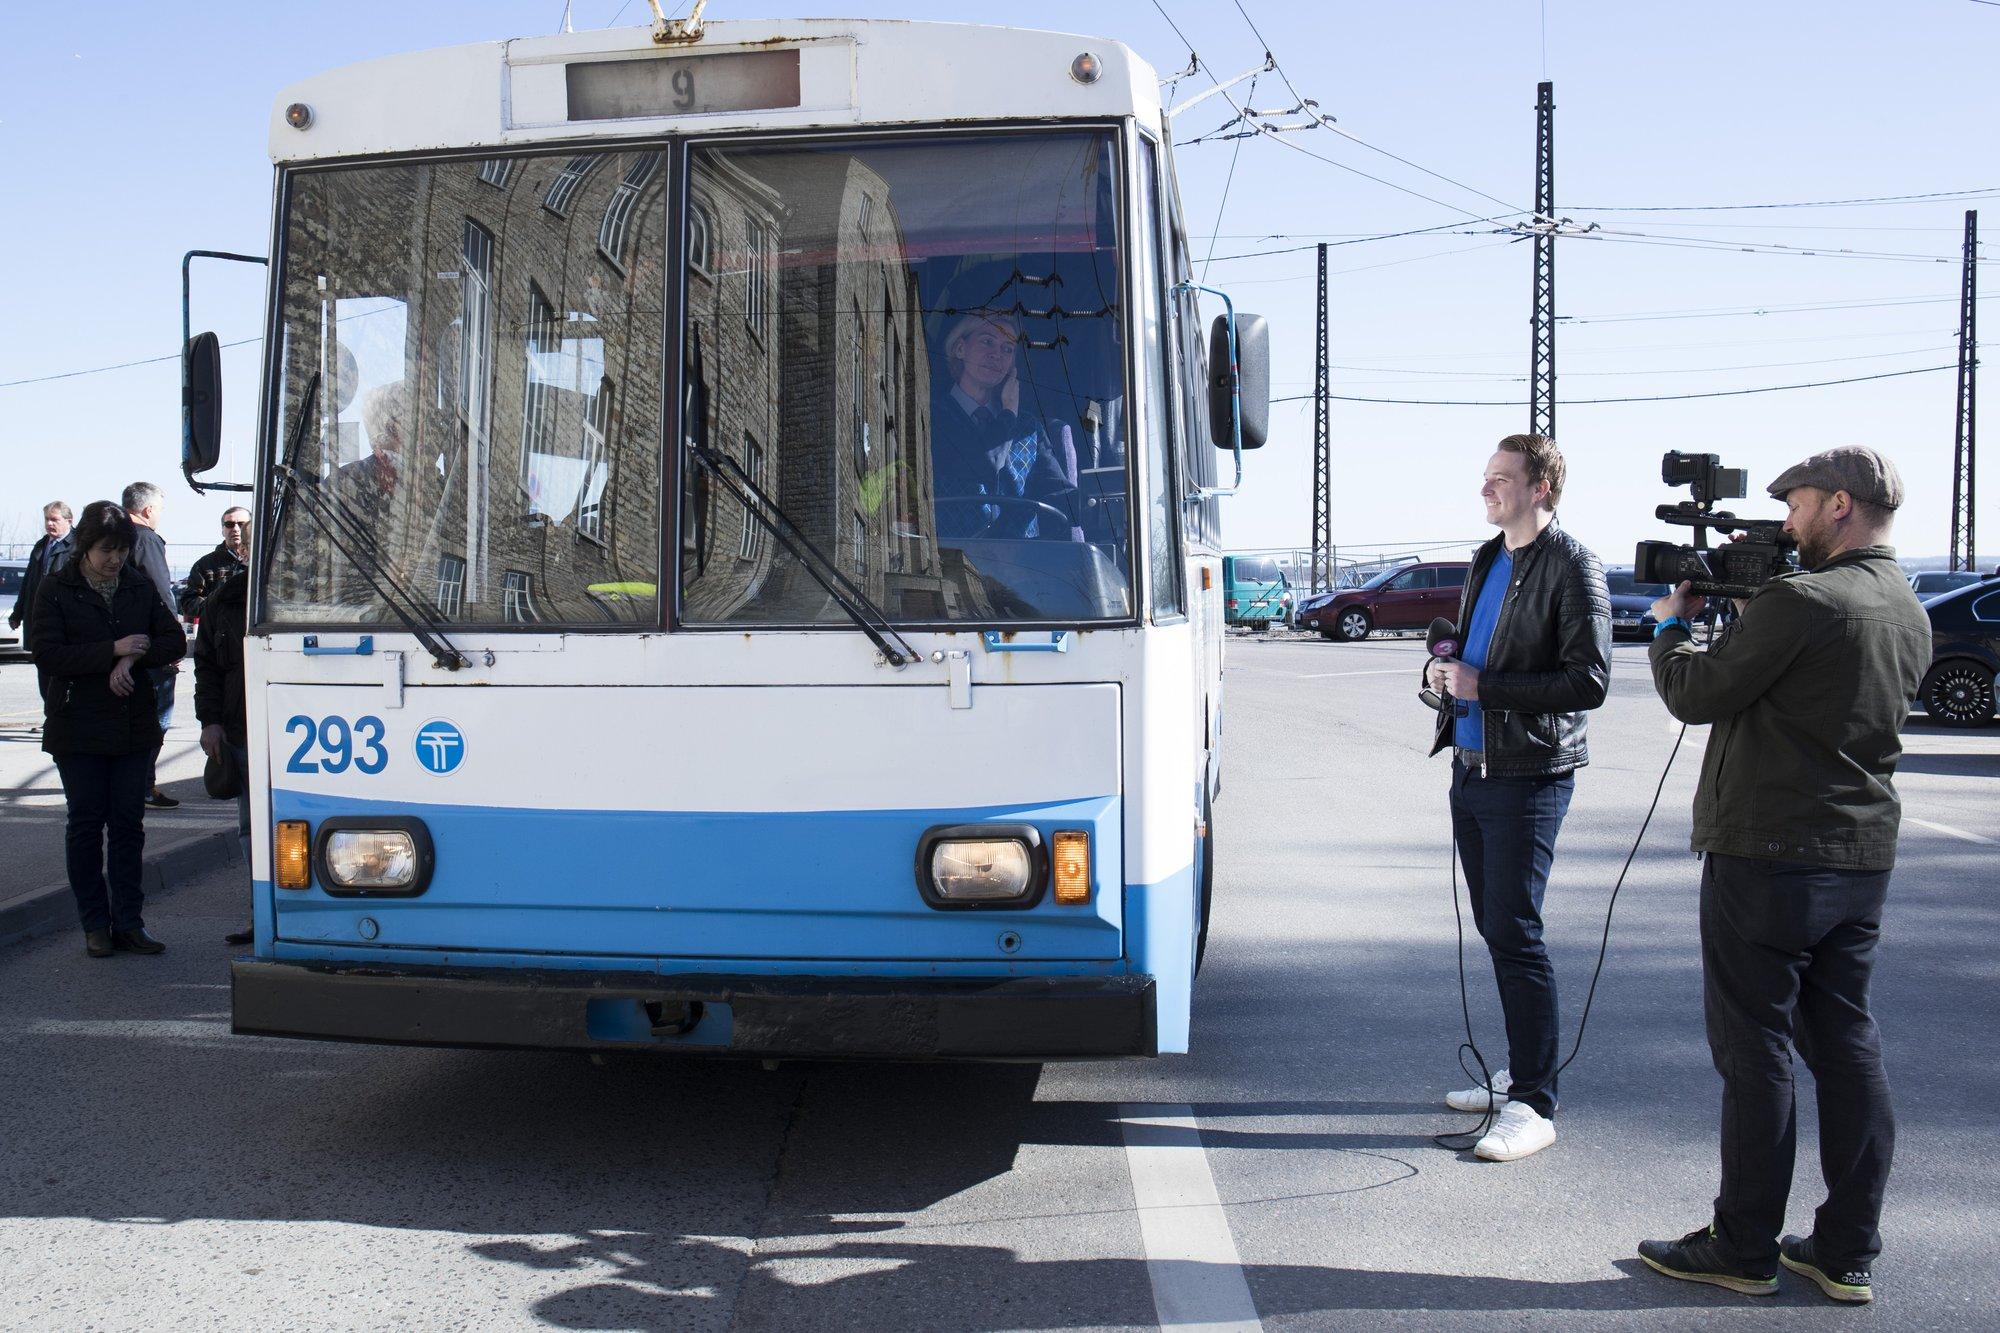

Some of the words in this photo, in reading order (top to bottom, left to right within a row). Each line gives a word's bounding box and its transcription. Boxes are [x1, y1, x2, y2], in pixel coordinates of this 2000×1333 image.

[671, 69, 695, 111] 9
[1438, 642, 1453, 655] 3
[285, 714, 389, 775] 293
